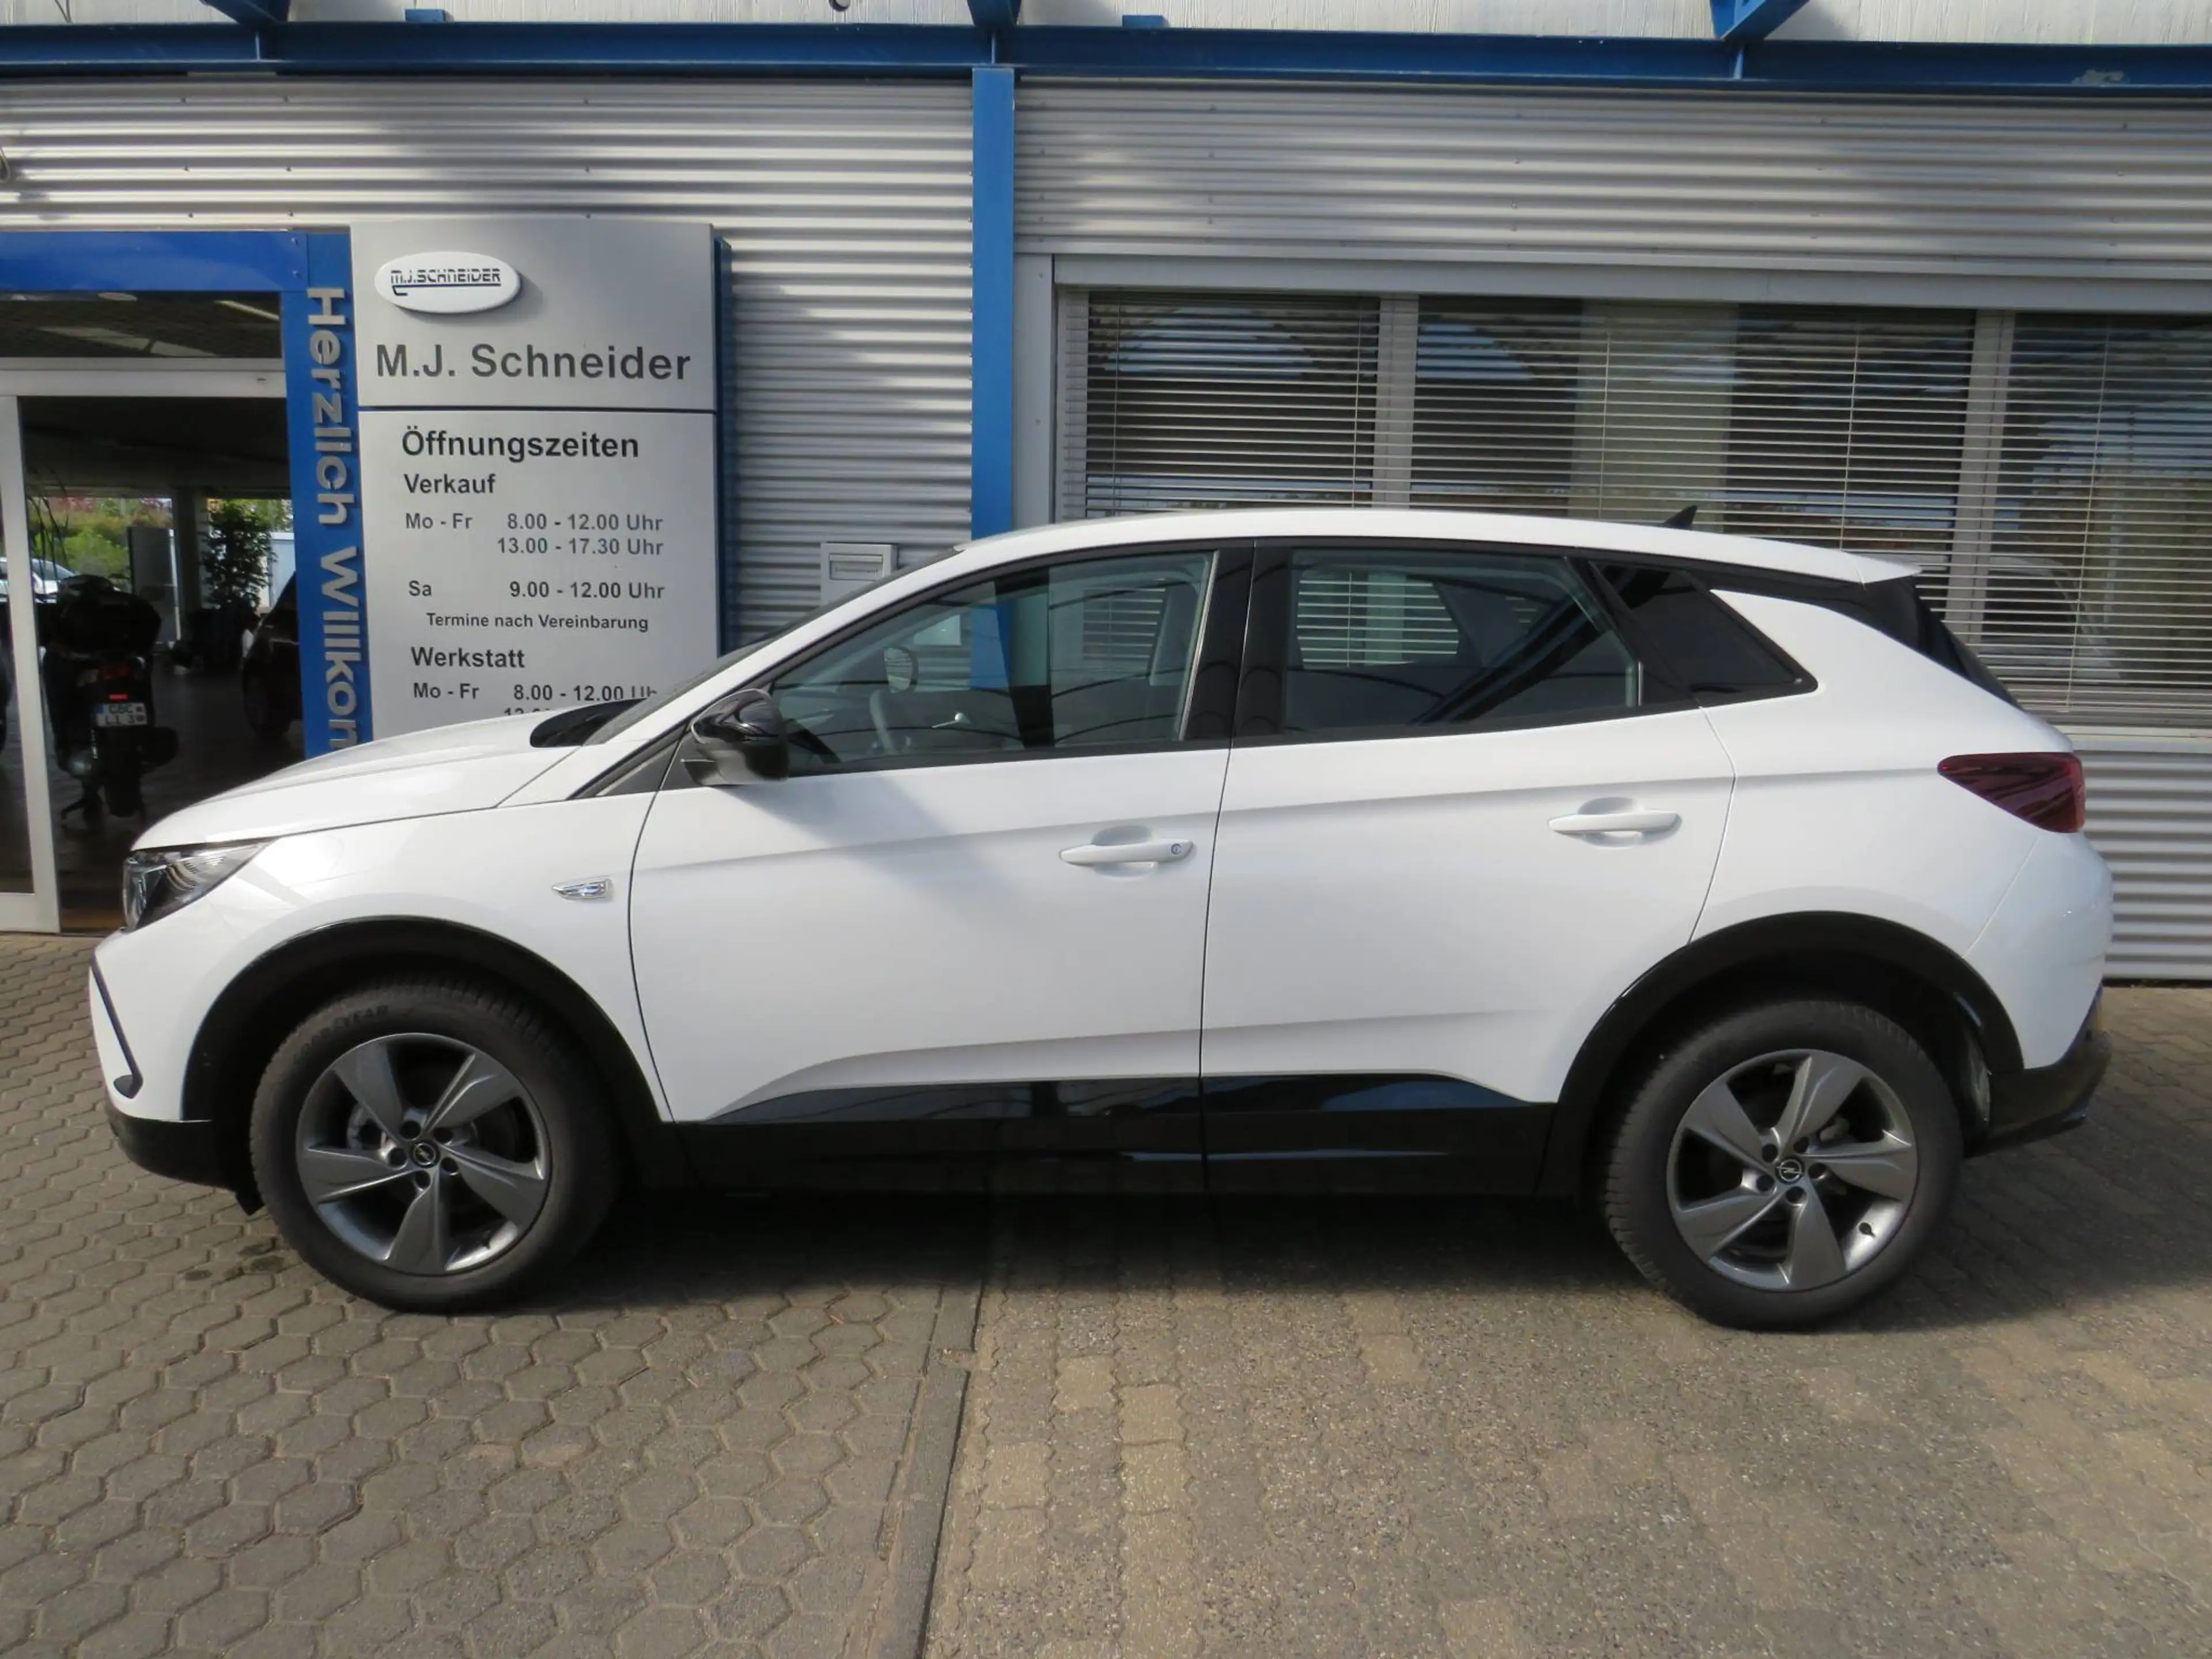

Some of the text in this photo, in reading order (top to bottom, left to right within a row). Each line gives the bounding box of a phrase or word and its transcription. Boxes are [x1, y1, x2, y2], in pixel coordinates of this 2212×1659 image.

[376, 343, 691, 380] M.J. Schneider
[402, 425, 639, 464] Öffnungszeiten
[403, 472, 497, 494] Verkauf
[306, 287, 361, 749] Herzlich Willkom
[406, 512, 434, 529] Mo
[452, 512, 473, 529] Fr
[507, 513, 547, 531] 8.00
[567, 513, 619, 531] 12.00
[626, 513, 663, 531] Uhr
[497, 536, 548, 554] 13.00
[569, 537, 620, 555] 17.30
[627, 537, 664, 555] Uhr
[408, 579, 432, 597] Sa
[509, 580, 550, 598] 9.00
[570, 581, 622, 599] 12.00
[628, 582, 665, 599] Uhr
[426, 612, 649, 633] Termine nach Vereinbarung
[410, 646, 526, 669] Werkstatt
[413, 682, 441, 699] Mo
[459, 683, 480, 700] Fr
[513, 684, 553, 701] 8.00
[573, 684, 624, 702] 12.00
[631, 685, 657, 698] Uh
